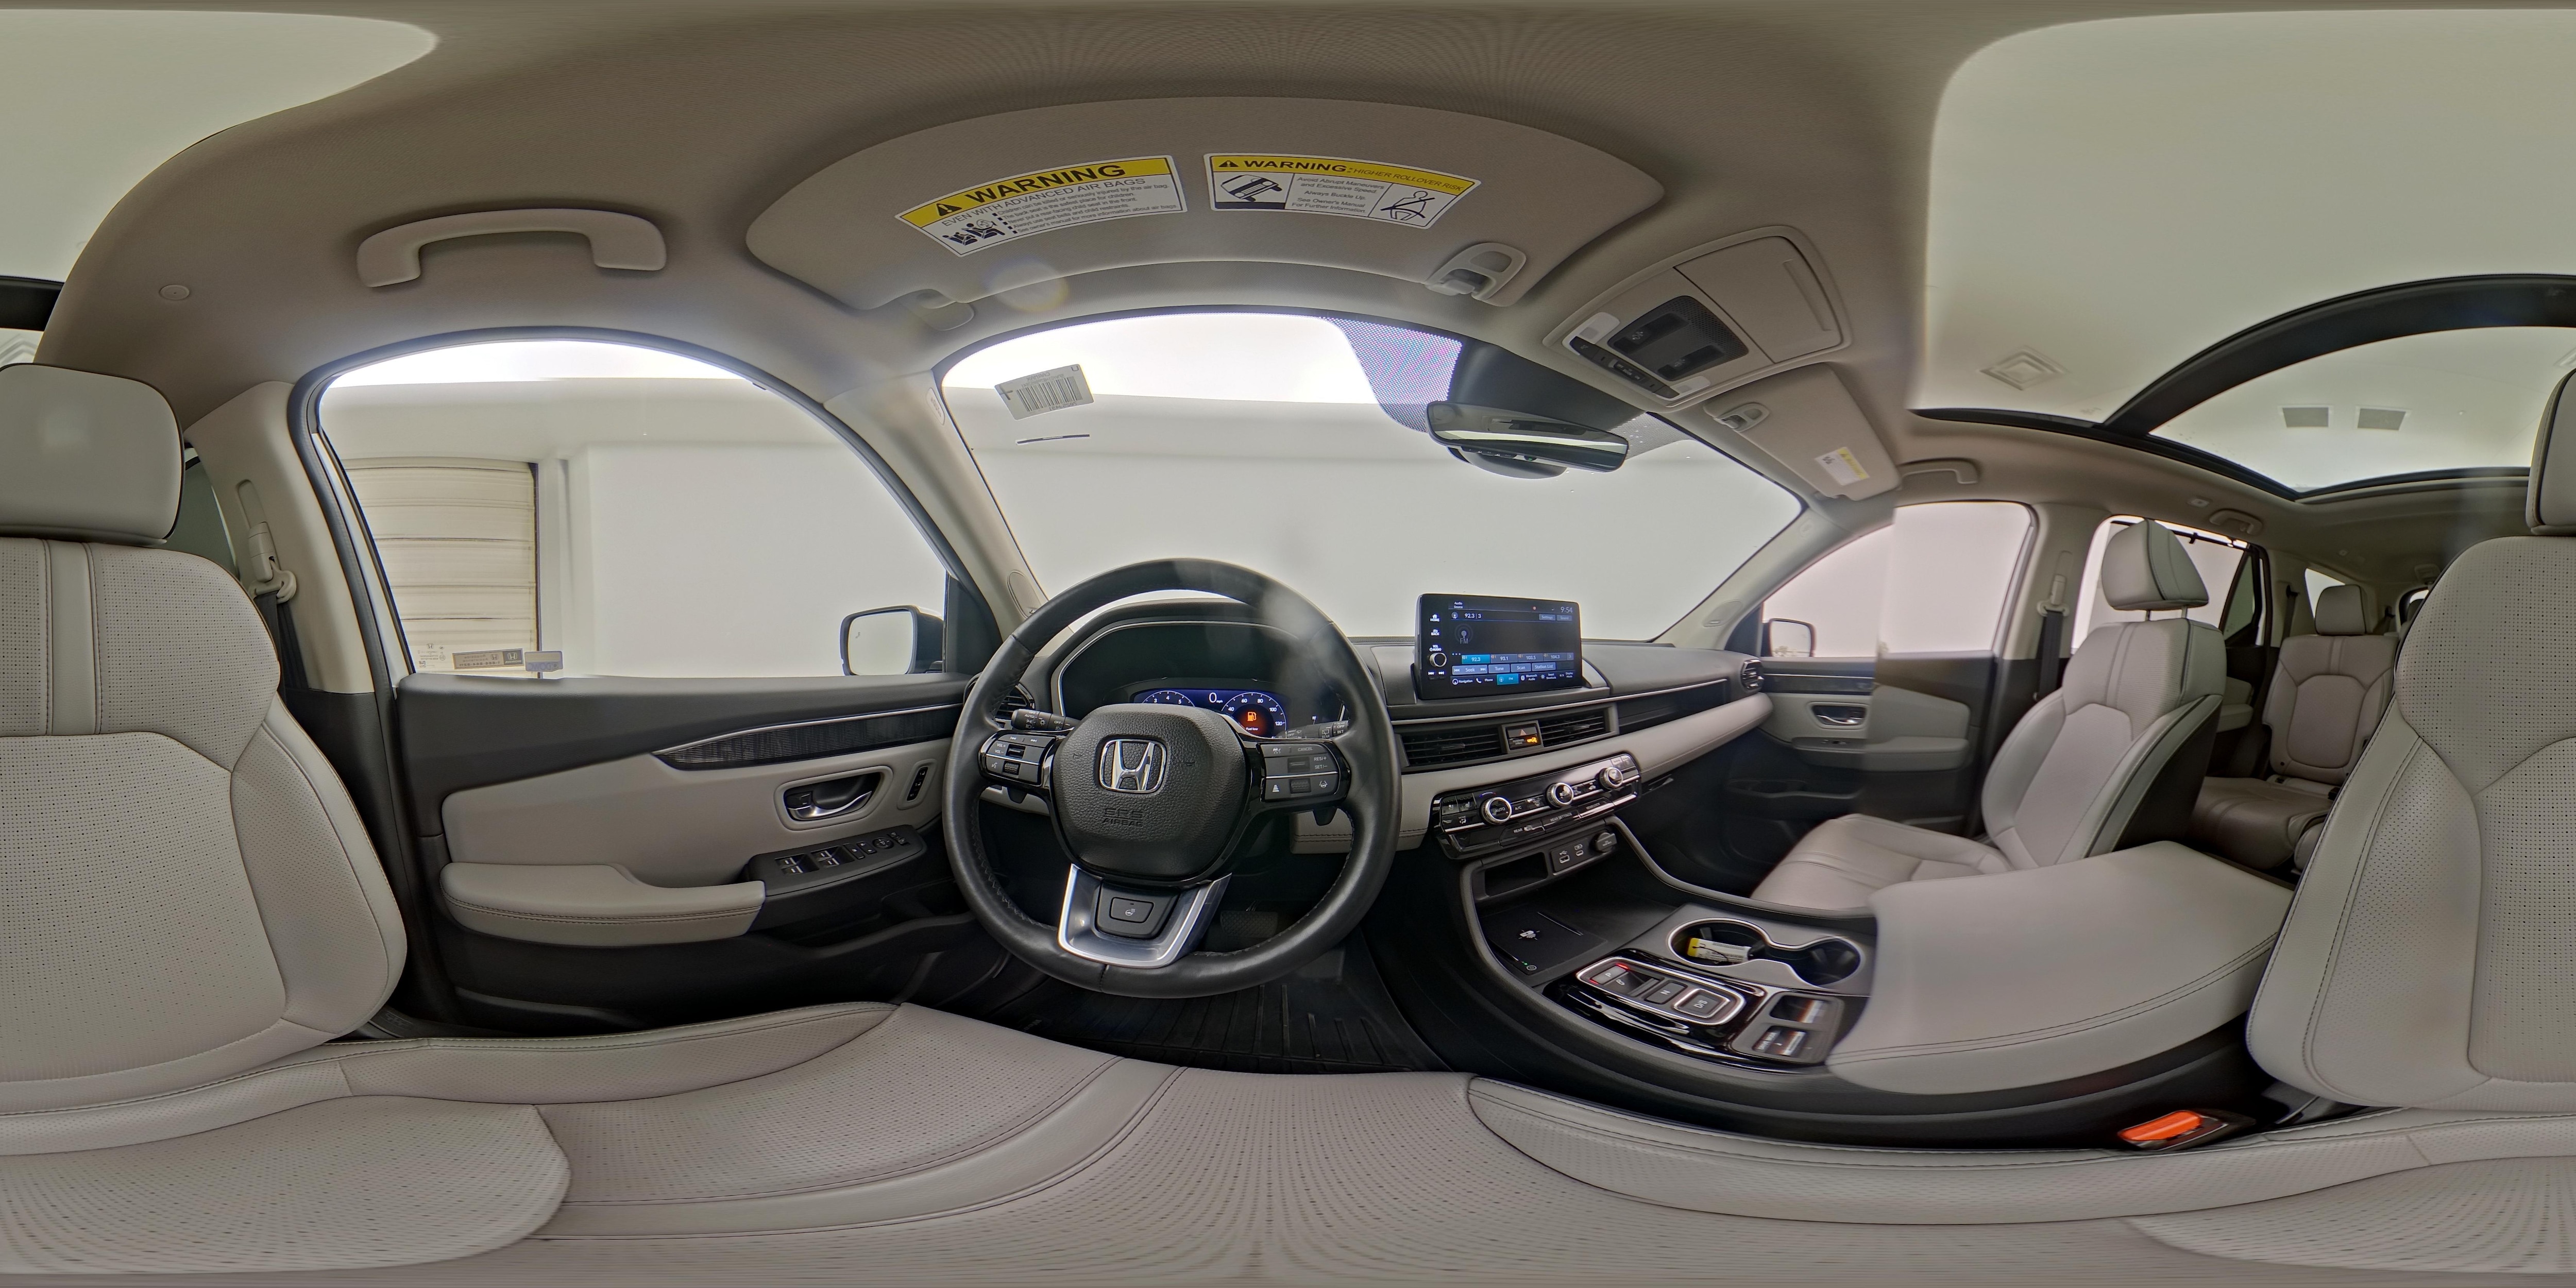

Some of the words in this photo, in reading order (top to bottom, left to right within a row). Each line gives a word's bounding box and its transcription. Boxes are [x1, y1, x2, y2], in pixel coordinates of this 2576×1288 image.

[964, 165, 1126, 203] WARNING
[1353, 168, 1392, 177] HIGHER
[1393, 174, 1441, 187] ROLLOVER
[1442, 182, 1464, 191] RISK
[1346, 181, 1384, 189] Maneuvers
[942, 213, 972, 227] EVEN
[971, 203, 1003, 215] WITH
[1005, 188, 1074, 207] ADVANCED
[1077, 183, 1101, 192] AIR
[1104, 178, 1146, 188] BAGS
[997, 206, 1021, 215] Children
[1040, 207, 1072, 216] rear-facing
[1209, 692, 1217, 703] 0
[1694, 1000, 1708, 1008] D/S
